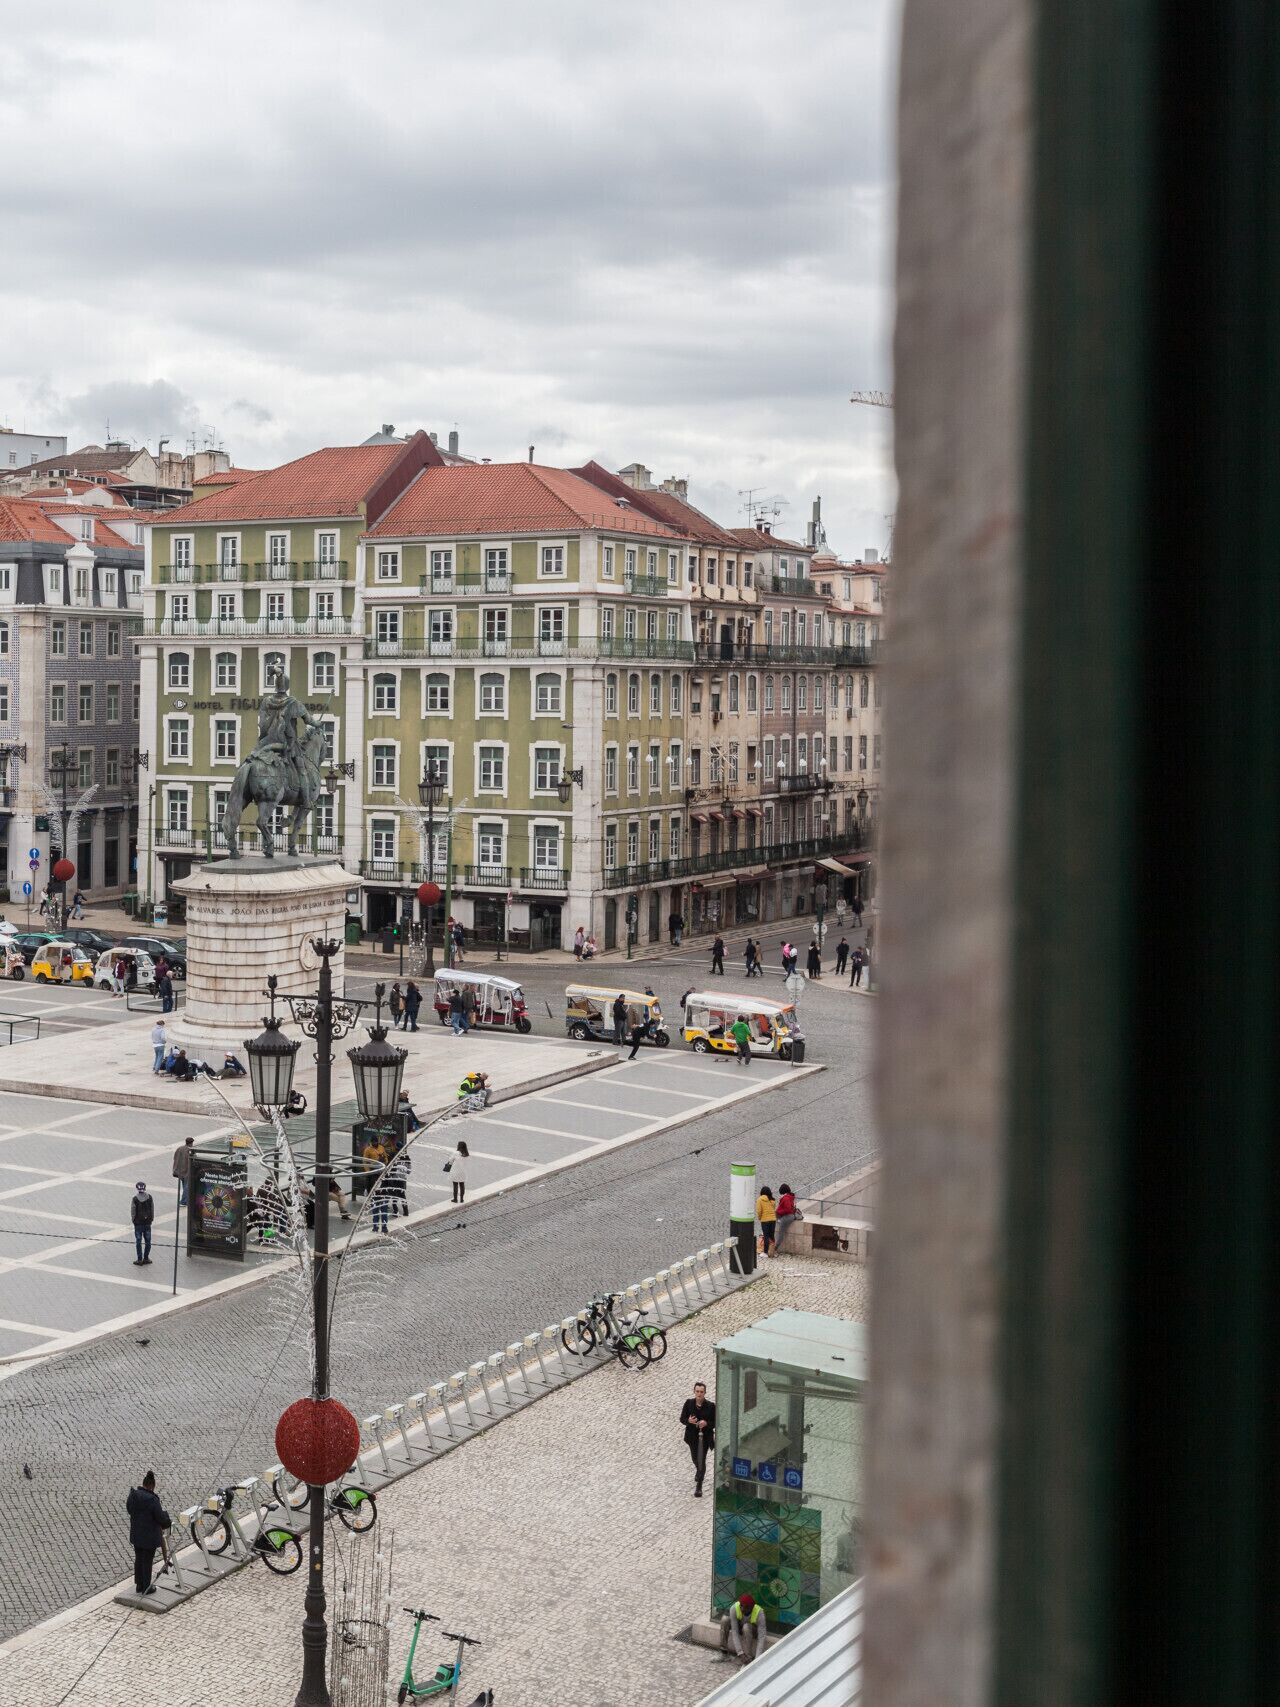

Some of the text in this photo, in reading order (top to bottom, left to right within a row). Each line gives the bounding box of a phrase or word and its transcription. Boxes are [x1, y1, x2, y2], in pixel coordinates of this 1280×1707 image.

[194, 701, 223, 710] HOTEL
[230, 698, 261, 711] FIGU
[225, 1236, 238, 1244] NOS
